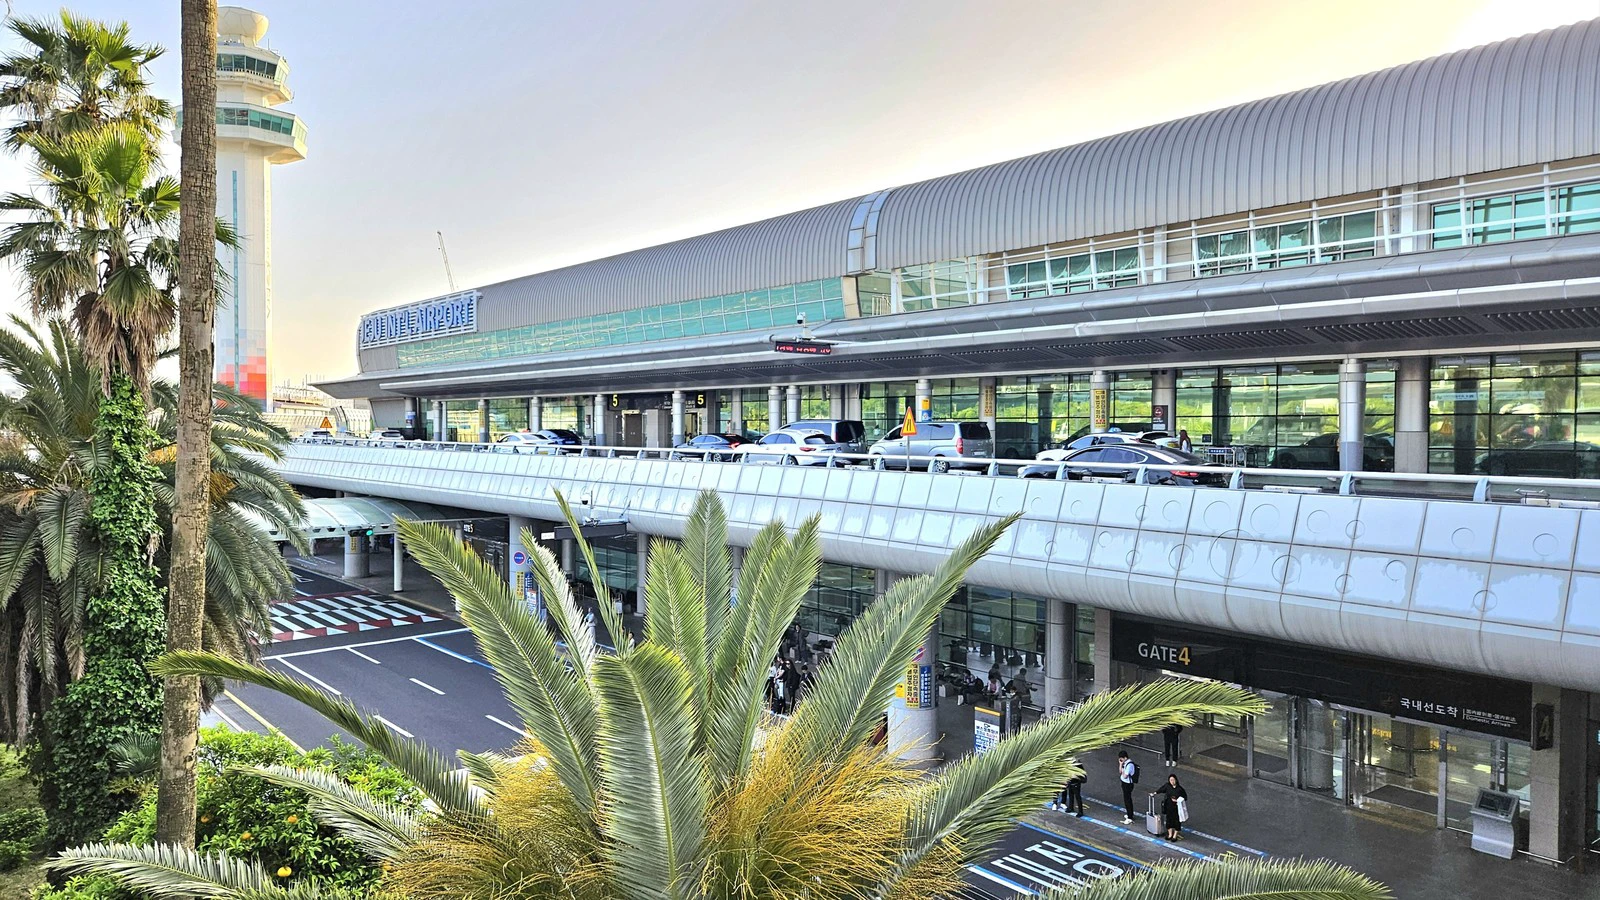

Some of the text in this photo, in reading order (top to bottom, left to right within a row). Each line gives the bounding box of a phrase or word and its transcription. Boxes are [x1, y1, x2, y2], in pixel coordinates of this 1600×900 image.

[415, 297, 472, 334] AIRPORT
[612, 394, 618, 407] 5
[697, 394, 704, 405] 5
[1400, 697, 1458, 718] 국내선도착
